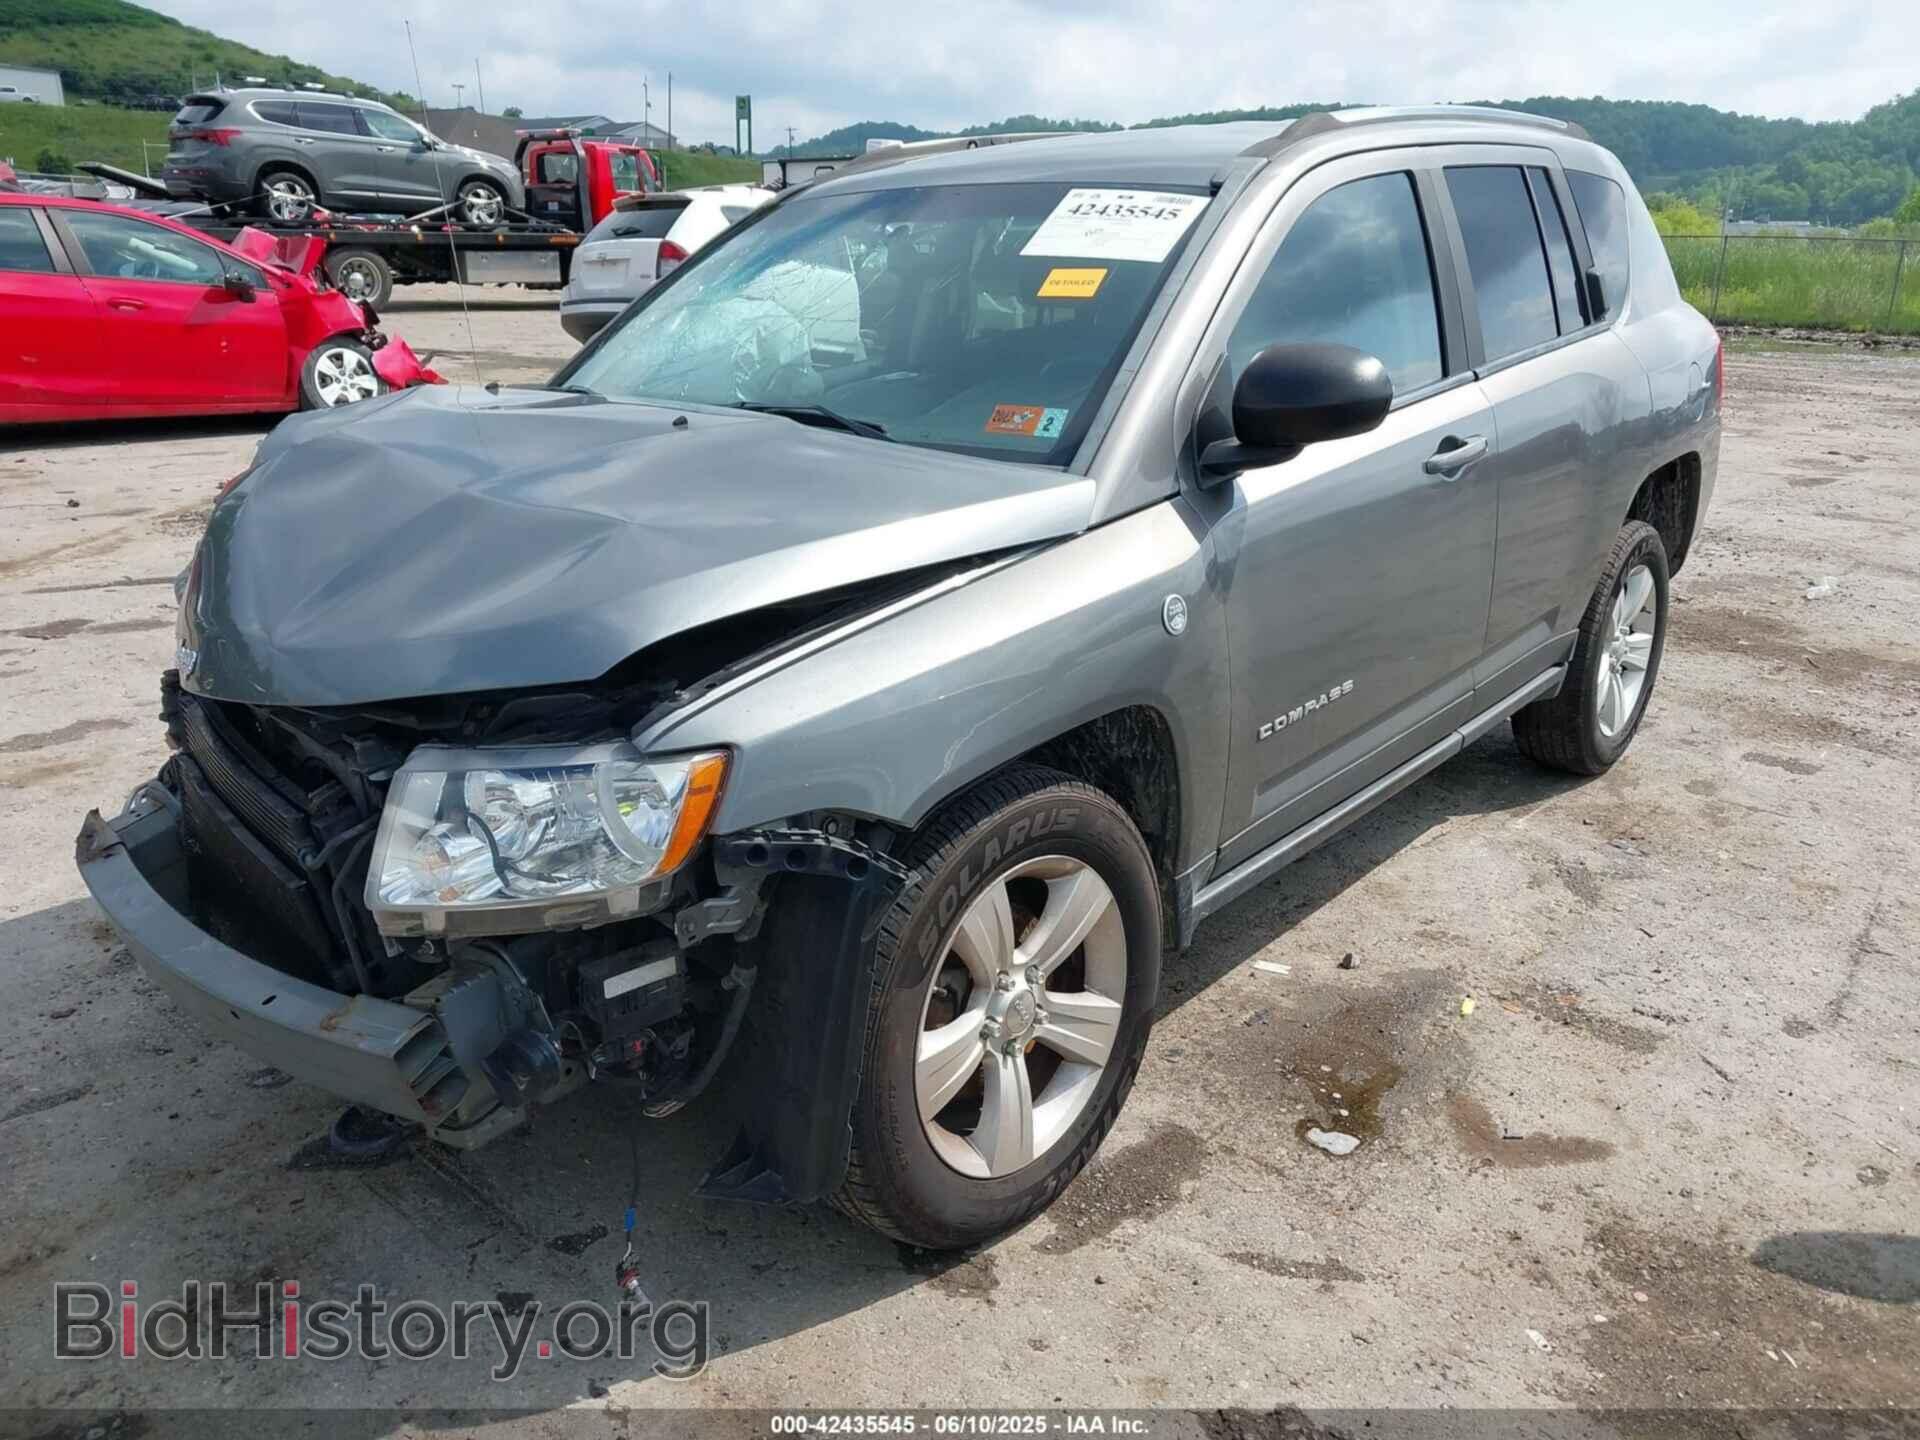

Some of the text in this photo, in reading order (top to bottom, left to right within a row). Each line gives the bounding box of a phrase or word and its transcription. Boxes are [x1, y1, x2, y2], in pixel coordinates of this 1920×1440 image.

[1067, 203, 1183, 221] 42435545
[1042, 416, 1055, 433] 2
[1258, 679, 1354, 740] COMPASS
[918, 808, 1081, 968] SOLARUS
